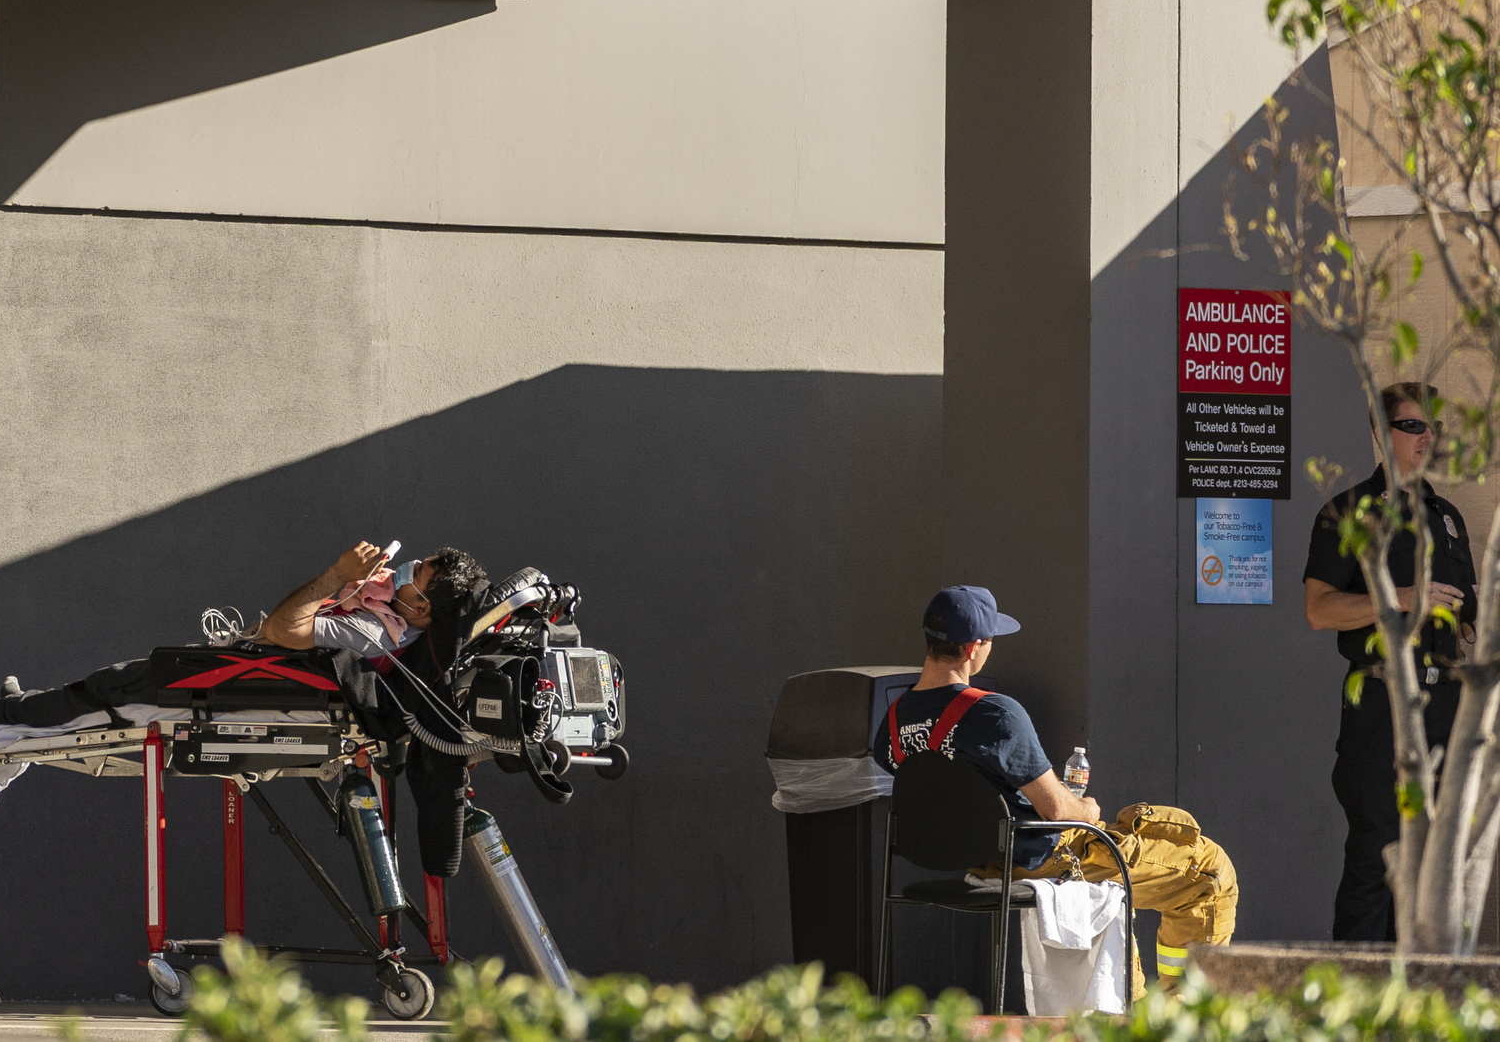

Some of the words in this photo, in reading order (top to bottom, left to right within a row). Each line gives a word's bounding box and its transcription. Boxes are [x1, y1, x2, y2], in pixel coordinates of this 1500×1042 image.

[1185, 301, 1285, 324] AMBULANCE
[1185, 332, 1221, 353] AND
[1227, 333, 1285, 354] POLICE
[1185, 359, 1244, 384] Parking
[1249, 361, 1285, 385] Only
[1186, 402, 1197, 414] All
[1199, 403, 1221, 414] Other
[1223, 403, 1257, 415] Vehicles
[1258, 404, 1271, 416] will
[1273, 405, 1284, 416] be
[1194, 421, 1229, 433] Ticketed
[1231, 422, 1237, 433] &
[1240, 422, 1265, 434] Towed
[1268, 423, 1276, 434] at
[1185, 440, 1214, 452] Vehicle
[1216, 440, 1248, 453] Owner's
[1250, 442, 1285, 454] Expense
[1189, 464, 1199, 474] Per
[1200, 465, 1218, 475] LAMC
[1192, 478, 1215, 488] POLICE
[1216, 479, 1232, 489] dept.
[1204, 511, 1232, 520] Welcome
[1233, 512, 1240, 520] to
[1215, 522, 1257, 531] Tobacco-Free
[1204, 531, 1240, 541] Smoke-Free
[1241, 534, 1265, 543] campus
